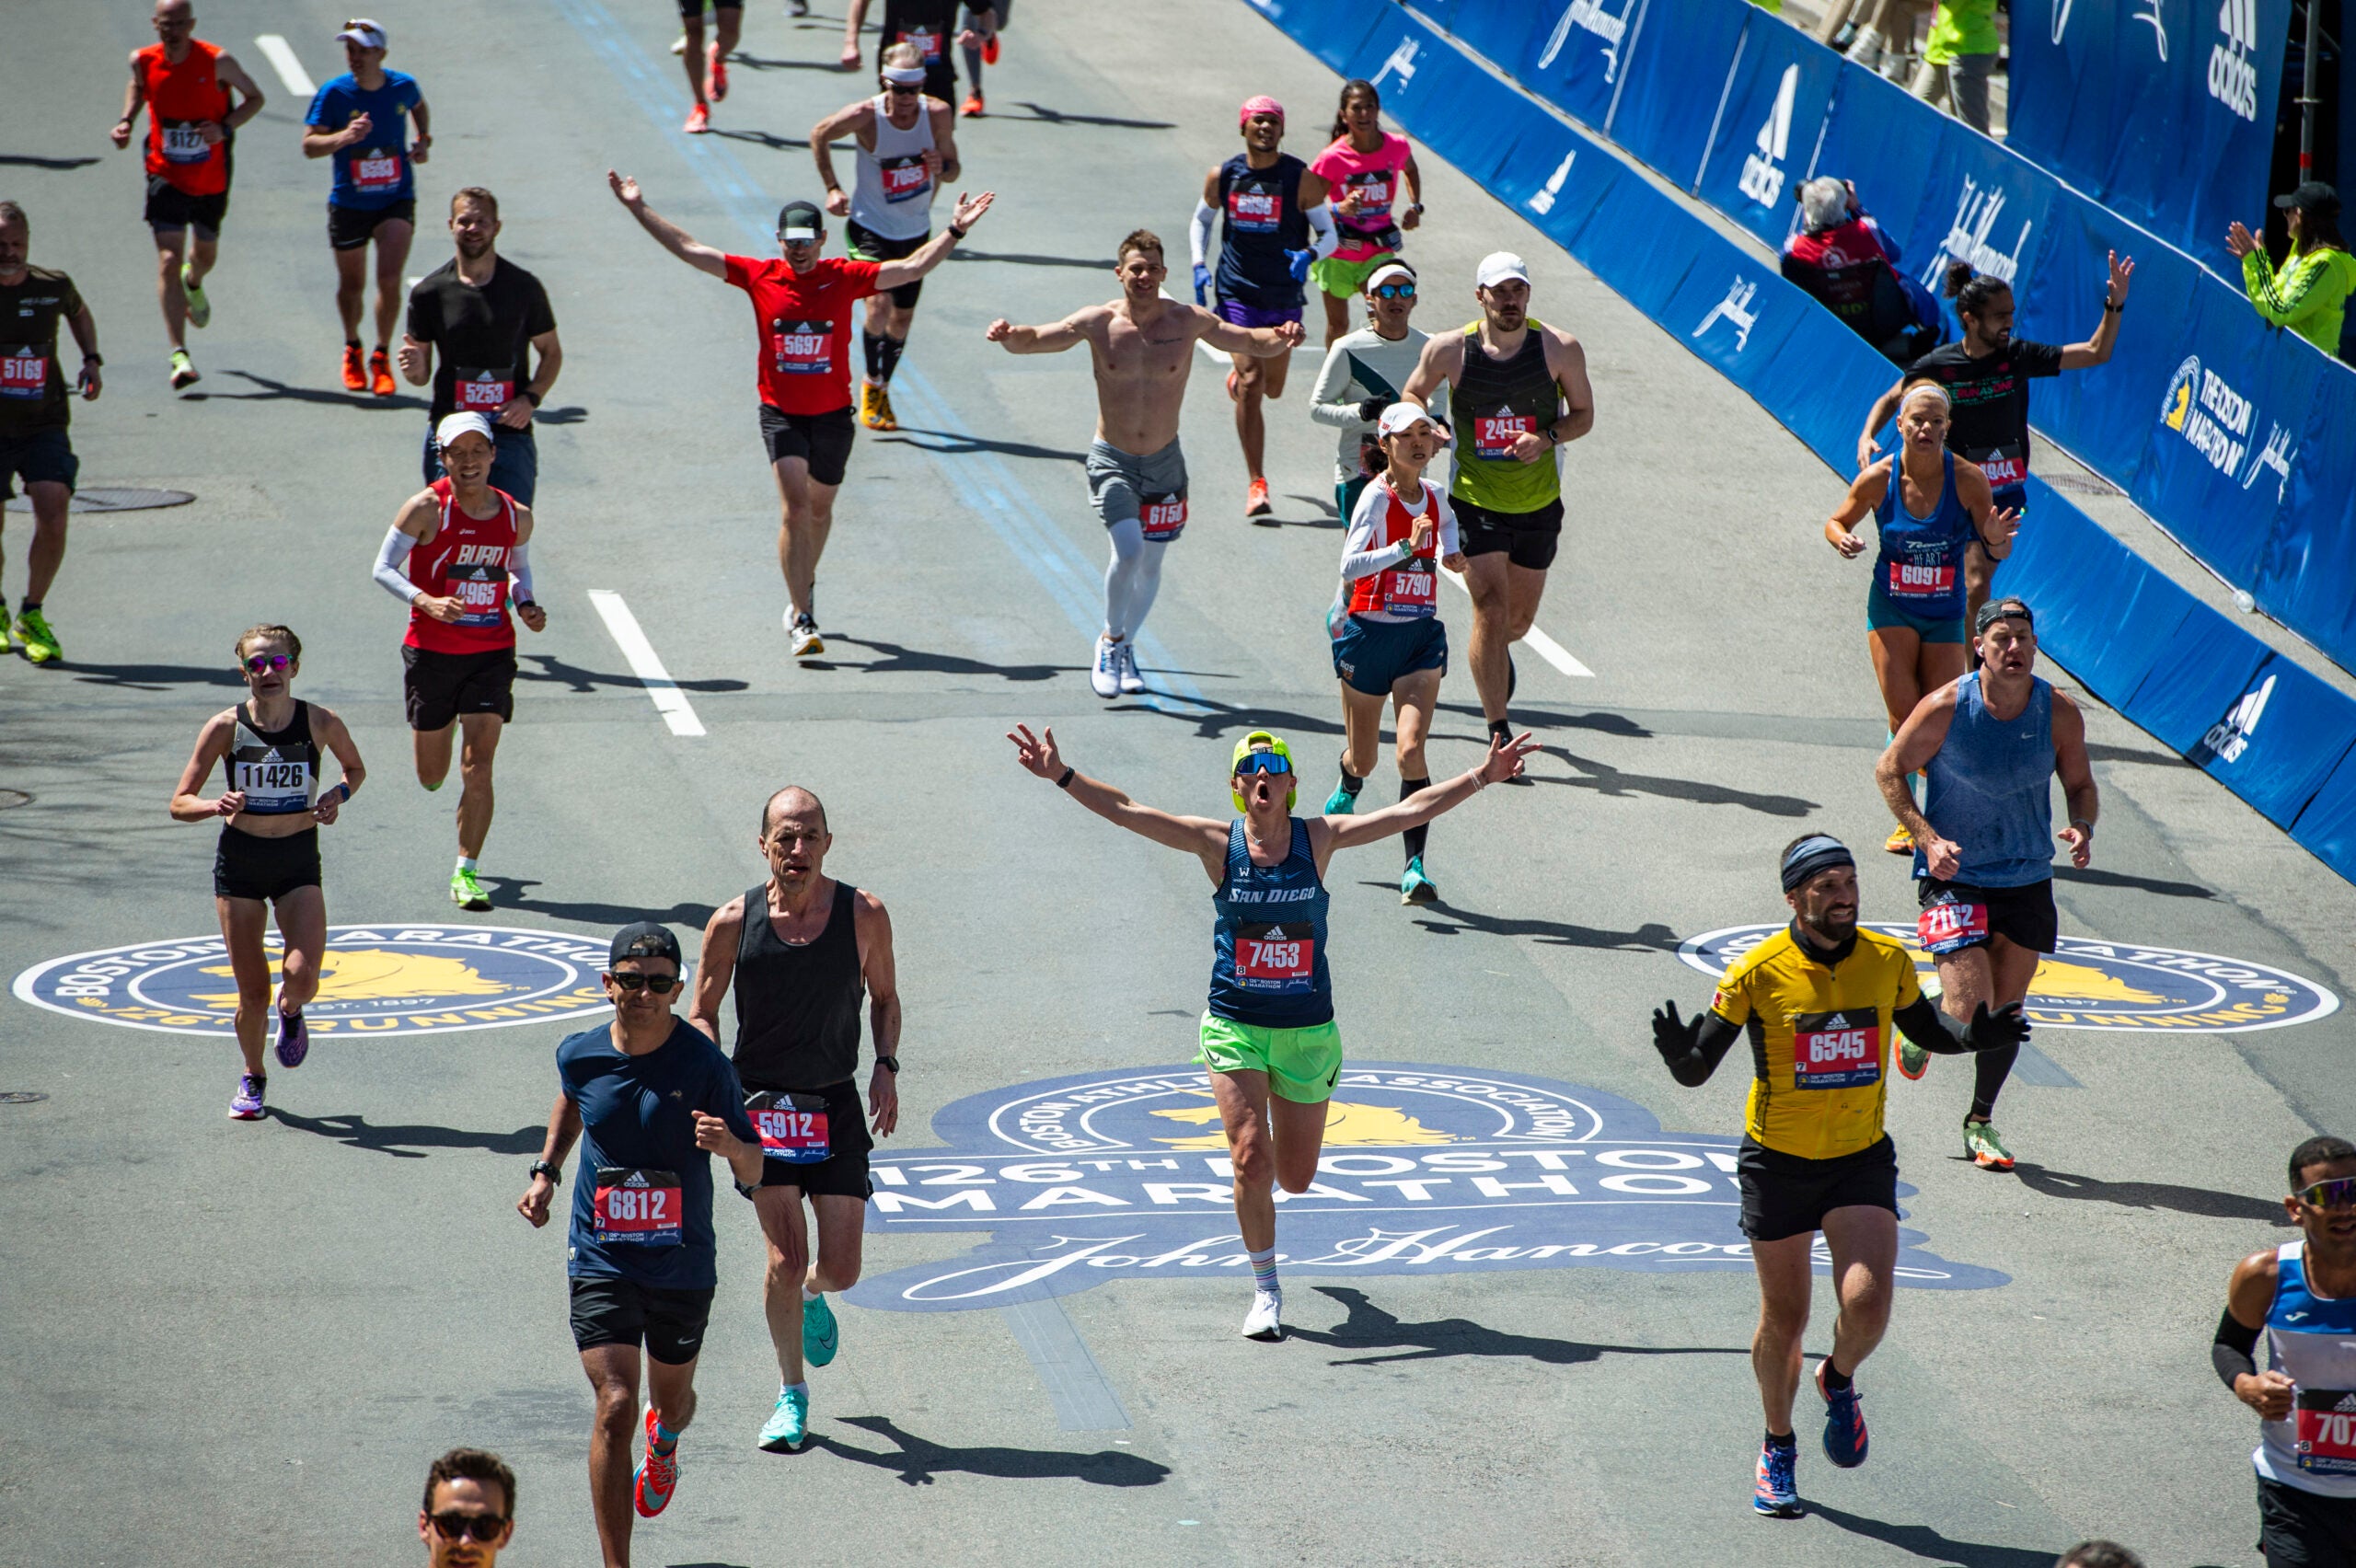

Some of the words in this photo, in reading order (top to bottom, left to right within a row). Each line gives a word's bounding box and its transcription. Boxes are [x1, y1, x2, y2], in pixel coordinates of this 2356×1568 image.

[783, 333, 825, 356] 5697
[4, 358, 43, 380] 5169
[465, 383, 504, 403] 5253
[1395, 573, 1432, 596] 5790
[1900, 564, 1942, 585] 6091
[243, 764, 303, 789] 11426
[1228, 887, 1264, 904] SAN
[1266, 886, 1316, 904] DIEGO
[1926, 904, 1975, 935] 7162
[1249, 942, 1300, 969] 7453
[54, 940, 226, 997] BOSTON
[1237, 966, 1245, 974] 8
[369, 997, 436, 1008] 1897
[2026, 1002, 2287, 1027] UNNING
[1809, 1031, 1865, 1063] 6545
[1019, 1101, 1098, 1149] BOSTON
[1068, 1075, 1209, 1105] ATHLE
[1340, 1073, 1576, 1137] ASSOCIATION
[758, 1112, 814, 1139] 5912
[869, 1159, 1180, 1186] 126TH
[607, 1190, 666, 1220] 6812
[902, 1233, 1288, 1301] John
